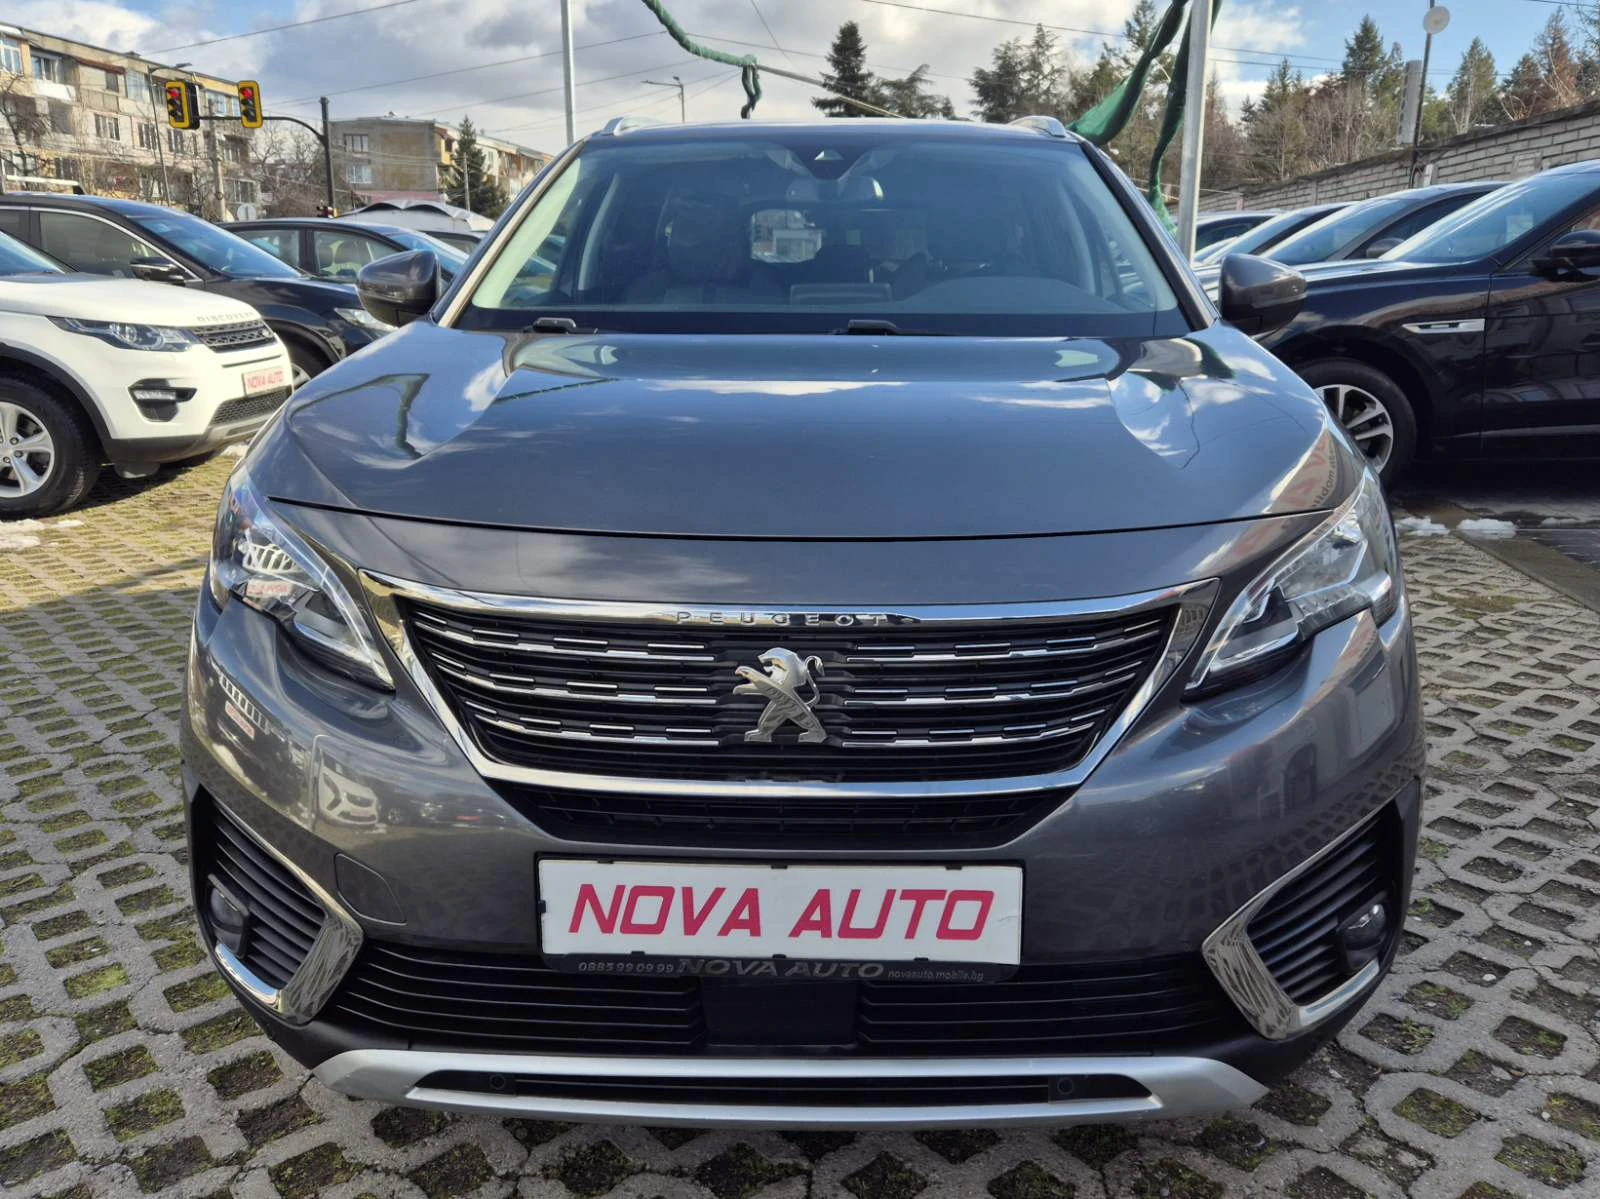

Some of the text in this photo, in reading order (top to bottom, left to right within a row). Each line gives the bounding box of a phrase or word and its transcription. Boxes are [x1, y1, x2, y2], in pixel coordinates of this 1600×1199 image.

[247, 371, 284, 388] NOVA AUTO
[676, 611, 888, 627] PEUGEOT
[568, 883, 995, 940] NOVA AUTO
[677, 958, 777, 976] NOVA
[784, 961, 884, 978] AUTO
